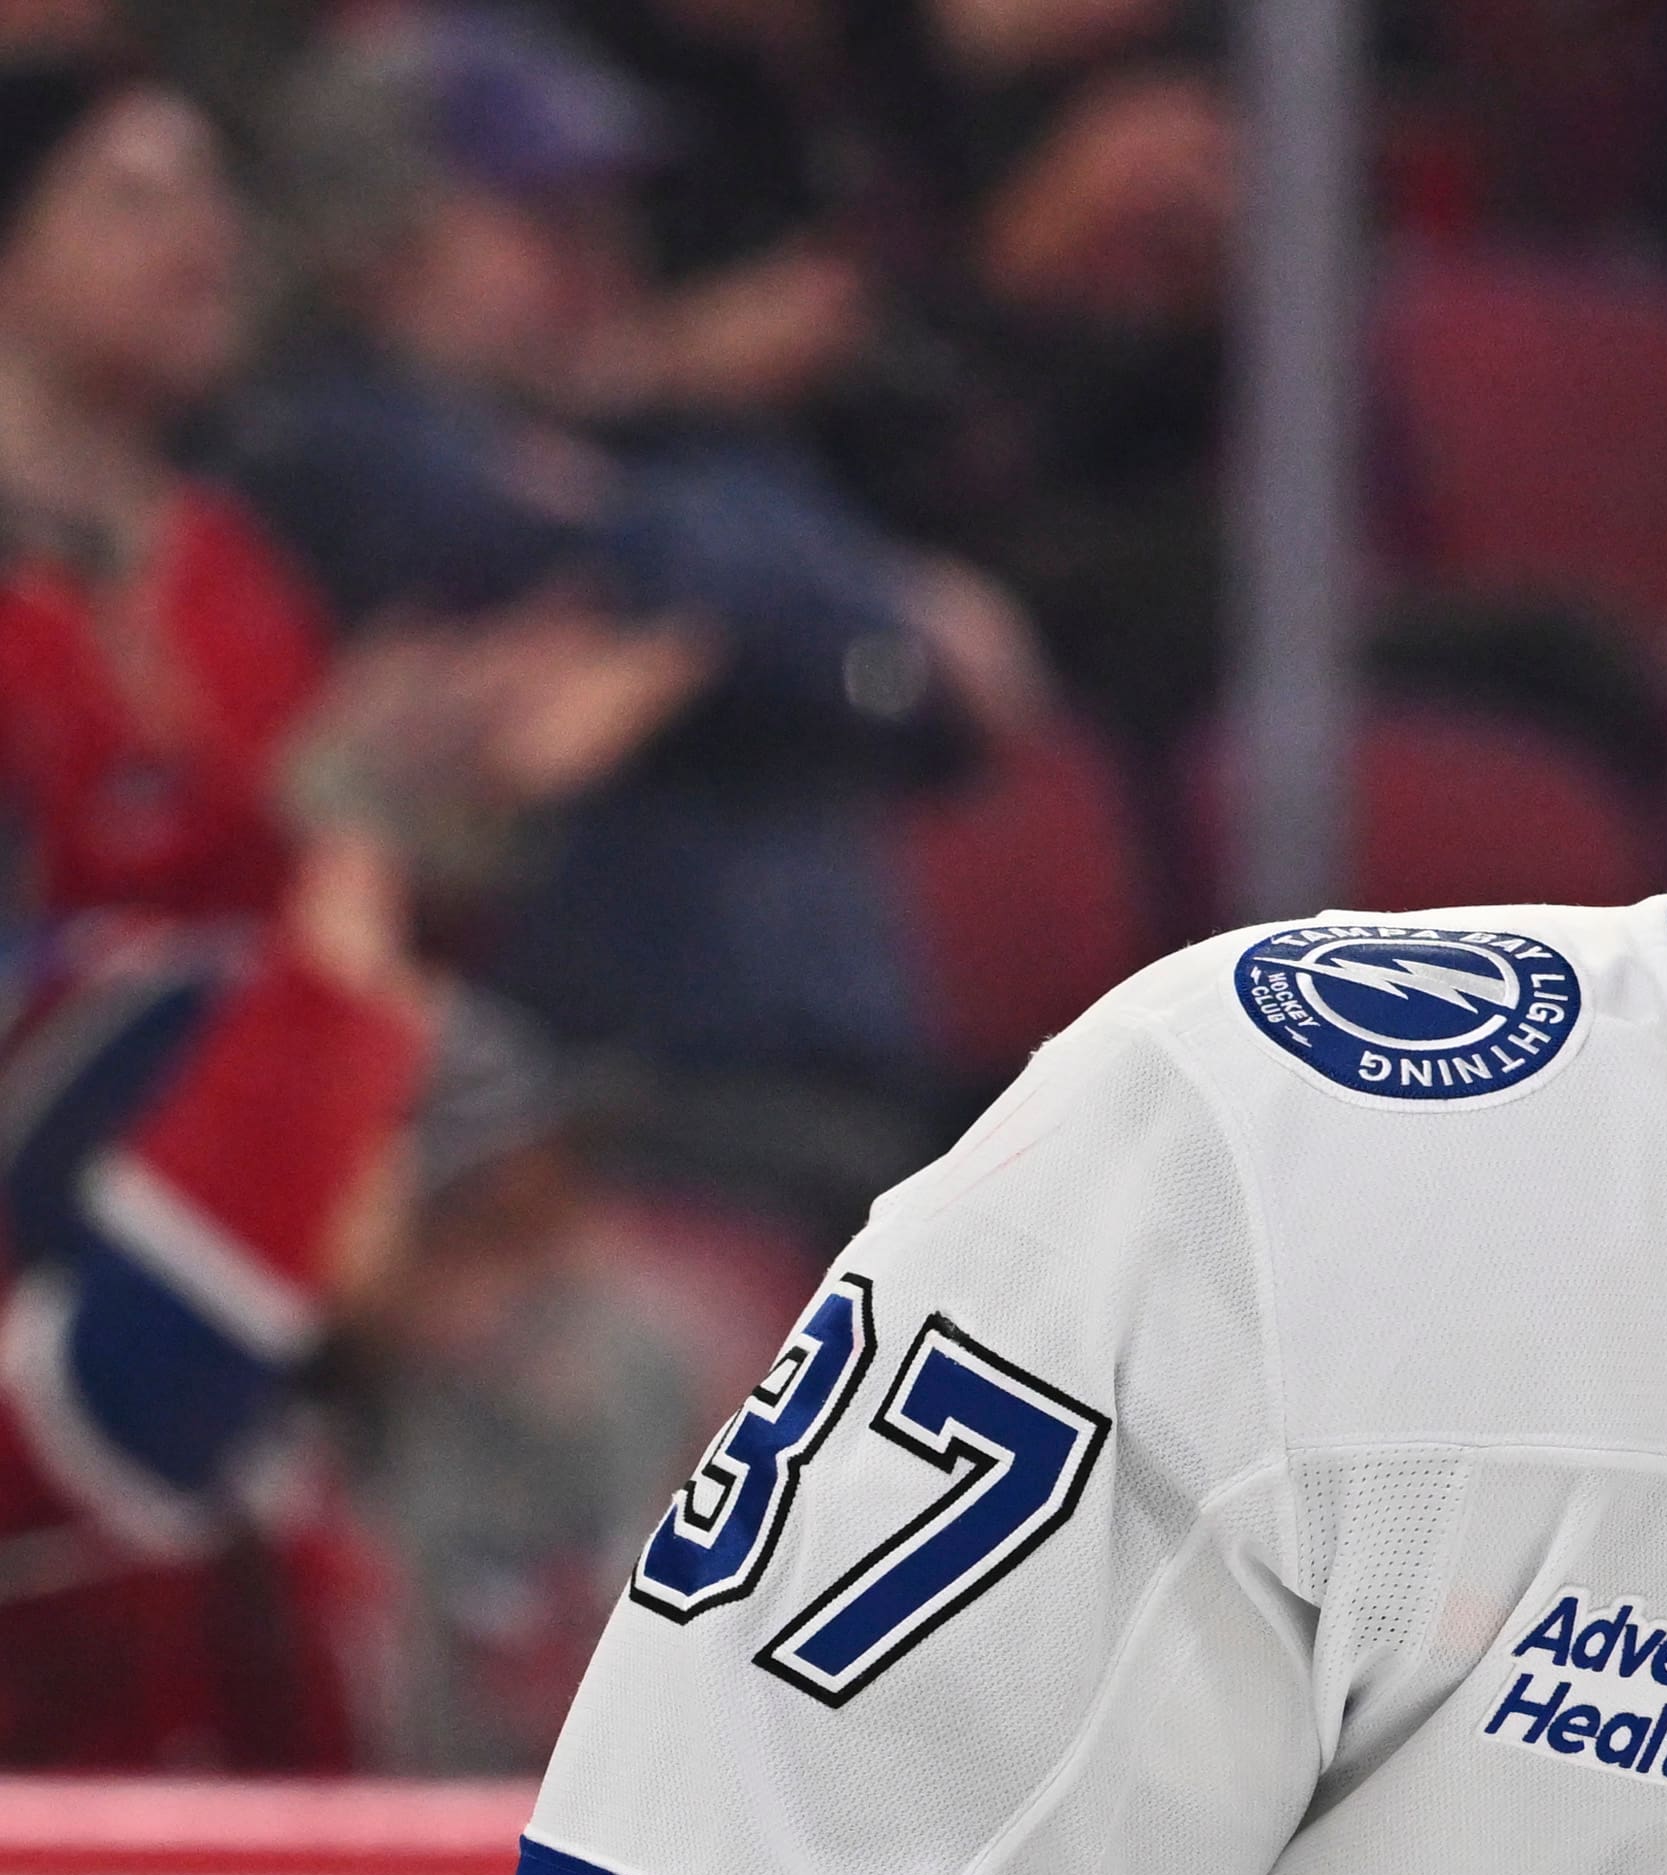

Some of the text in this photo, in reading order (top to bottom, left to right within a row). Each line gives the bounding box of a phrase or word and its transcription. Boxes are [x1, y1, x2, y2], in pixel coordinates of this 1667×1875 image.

[1251, 985, 1287, 1024] CLUB
[1268, 972, 1321, 1027] HOCKEY
[1271, 926, 1569, 1087] TAMPA BAY LIGHTNING
[629, 1271, 1112, 1709] 37
